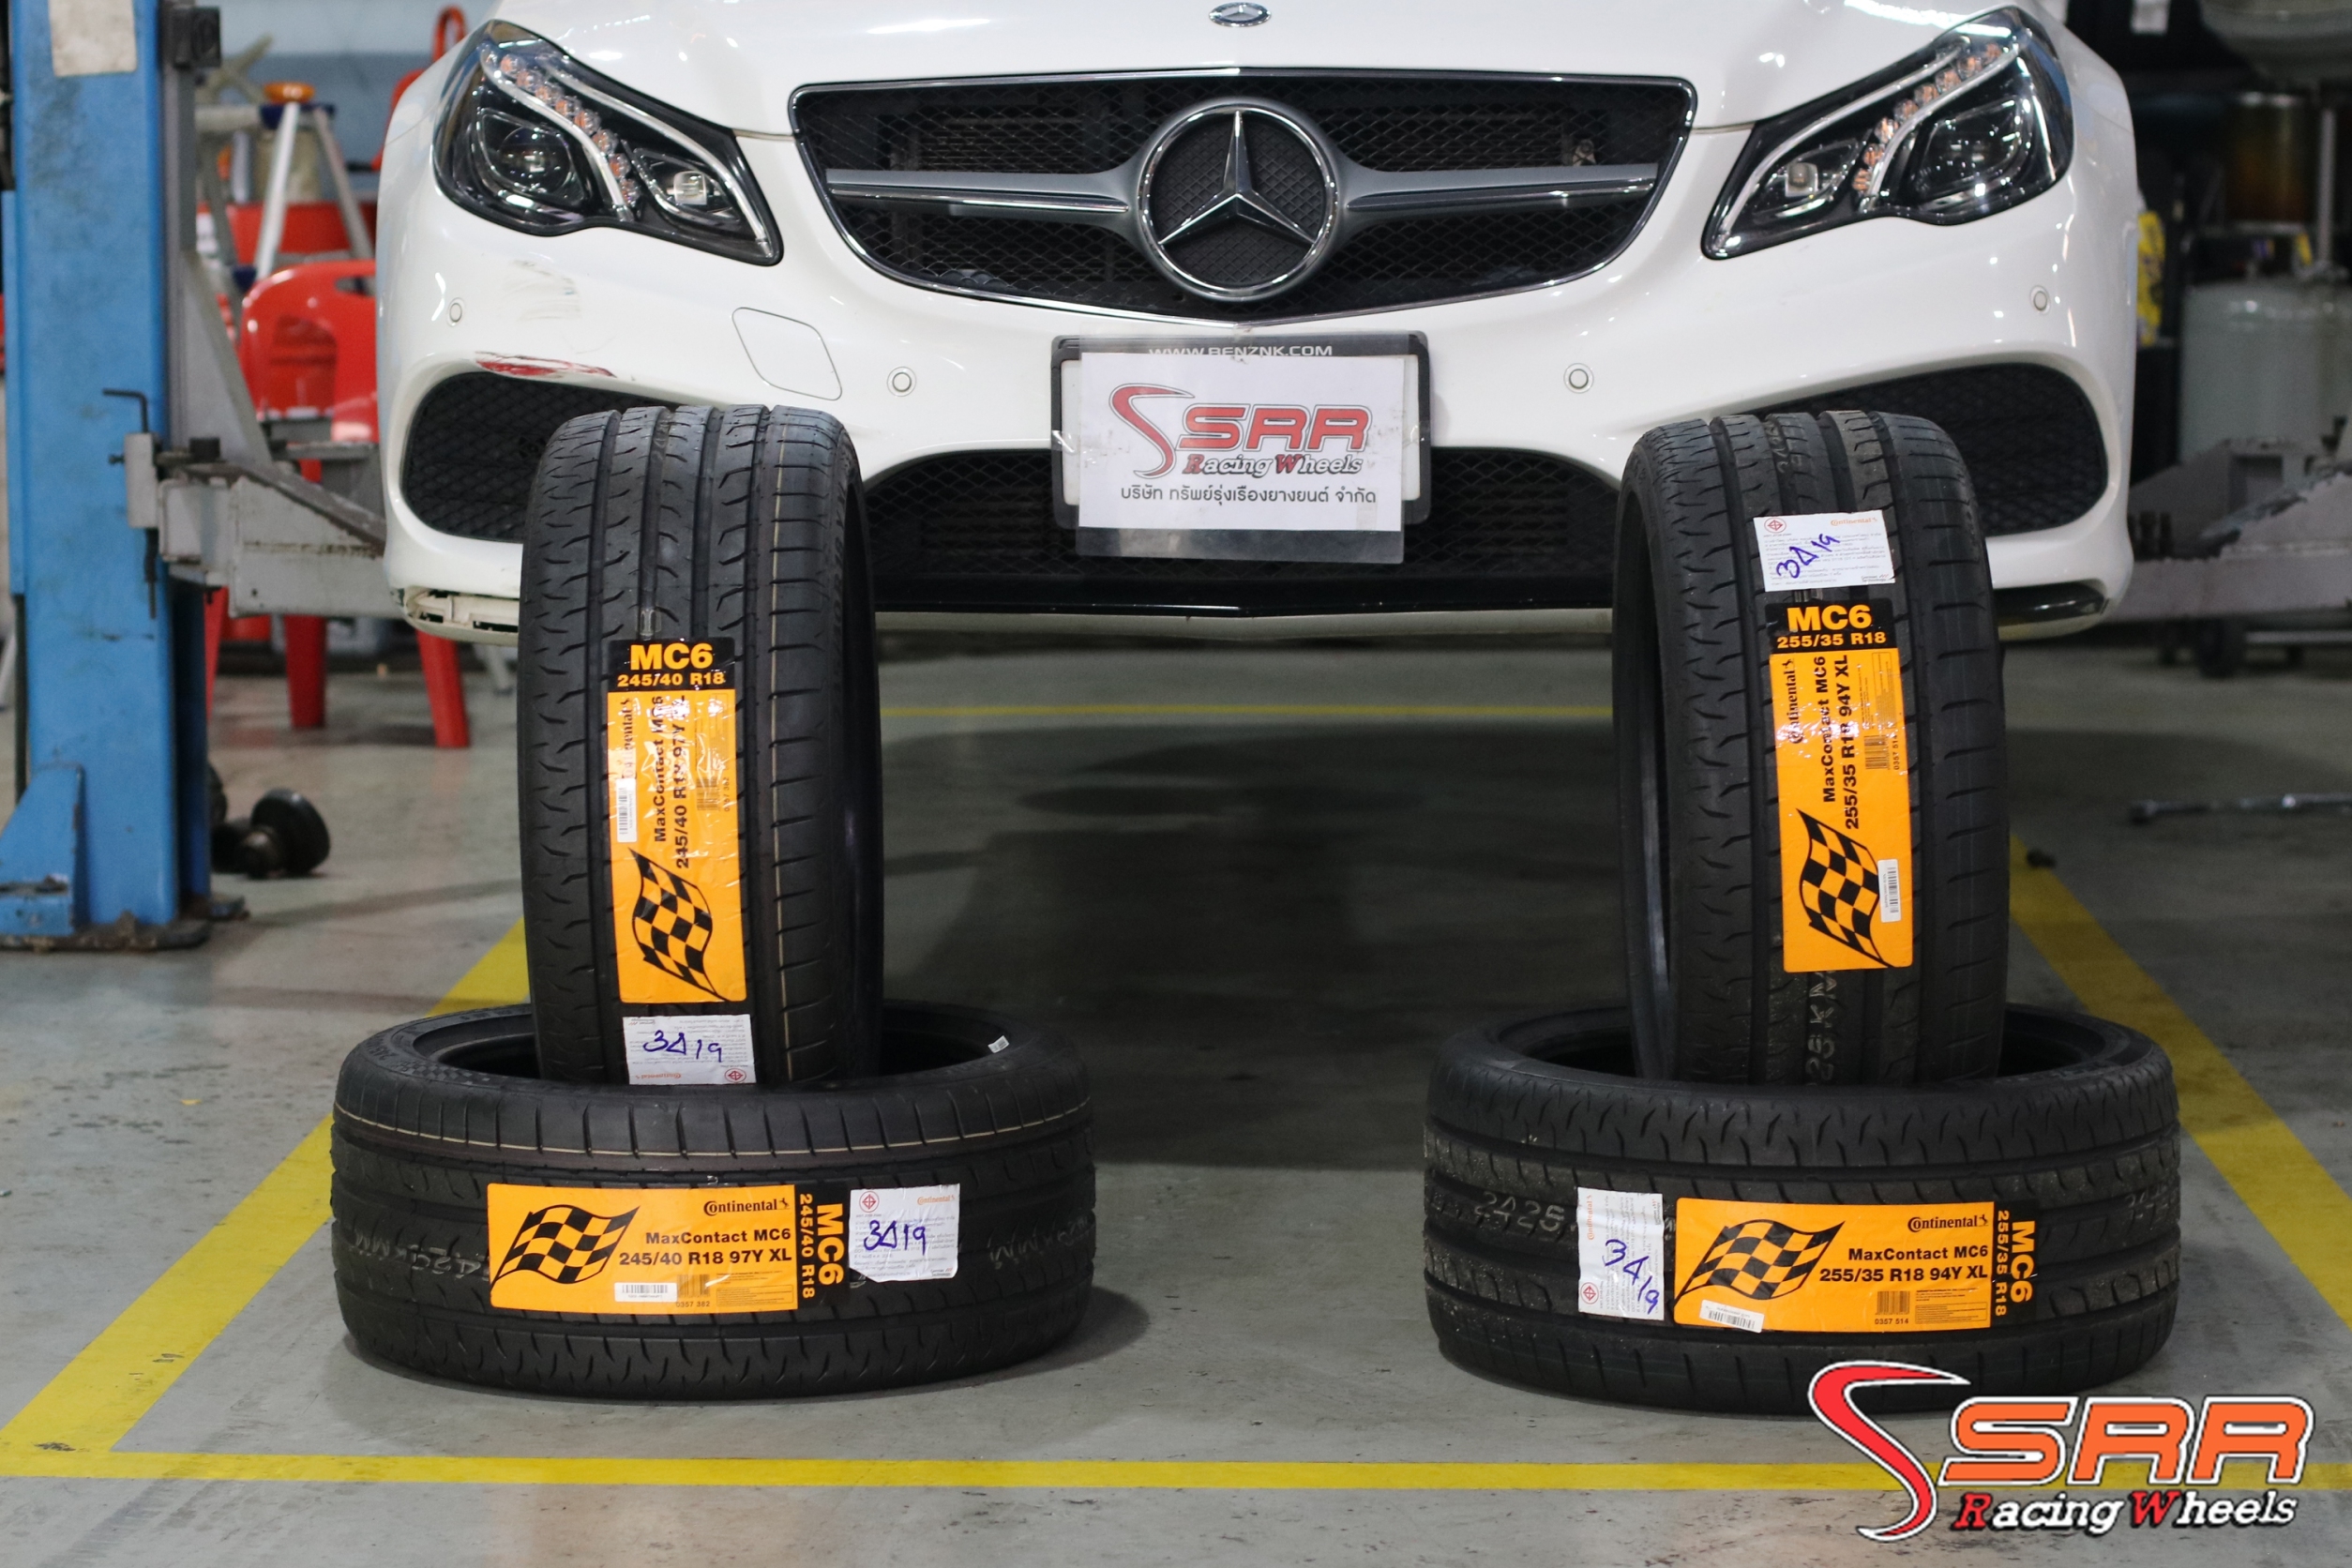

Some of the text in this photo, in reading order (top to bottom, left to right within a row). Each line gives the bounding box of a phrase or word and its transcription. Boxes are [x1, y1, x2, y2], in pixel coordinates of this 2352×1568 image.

[1183, 454, 1364, 478] Racing Wheels
[1121, 484, 1163, 500] บริษัท
[1335, 487, 1376, 504] จำกัด
[1831, 518, 1872, 526] Continental
[1787, 604, 1872, 632] MC6
[1776, 632, 1886, 648] 255/35 R18
[630, 642, 714, 671] MC6
[1834, 655, 1849, 678] XL
[617, 672, 725, 687] 245/40 R18
[1836, 684, 1852, 716] 94Y
[1814, 656, 1835, 803] MaxContact MC6
[654, 740, 667, 842] MaxContact
[1843, 764, 1860, 830] 255/35
[674, 805, 689, 868] 245/40
[704, 1199, 777, 1216] Continental
[917, 1196, 950, 1206] Continental
[1907, 1215, 1979, 1232] Continental
[645, 1228, 792, 1244] MaxContact MC6
[800, 1194, 816, 1299] 245/40 R18
[817, 1203, 845, 1286] MC6
[619, 1248, 792, 1266] 245/40 R18 97Y XL
[1848, 1244, 1988, 1261] MaxContact MC6
[1996, 1210, 2010, 1316] 255/35 R18
[2011, 1220, 2035, 1303] MC6
[1819, 1265, 1988, 1283] 255/35 R18 94Y XL
